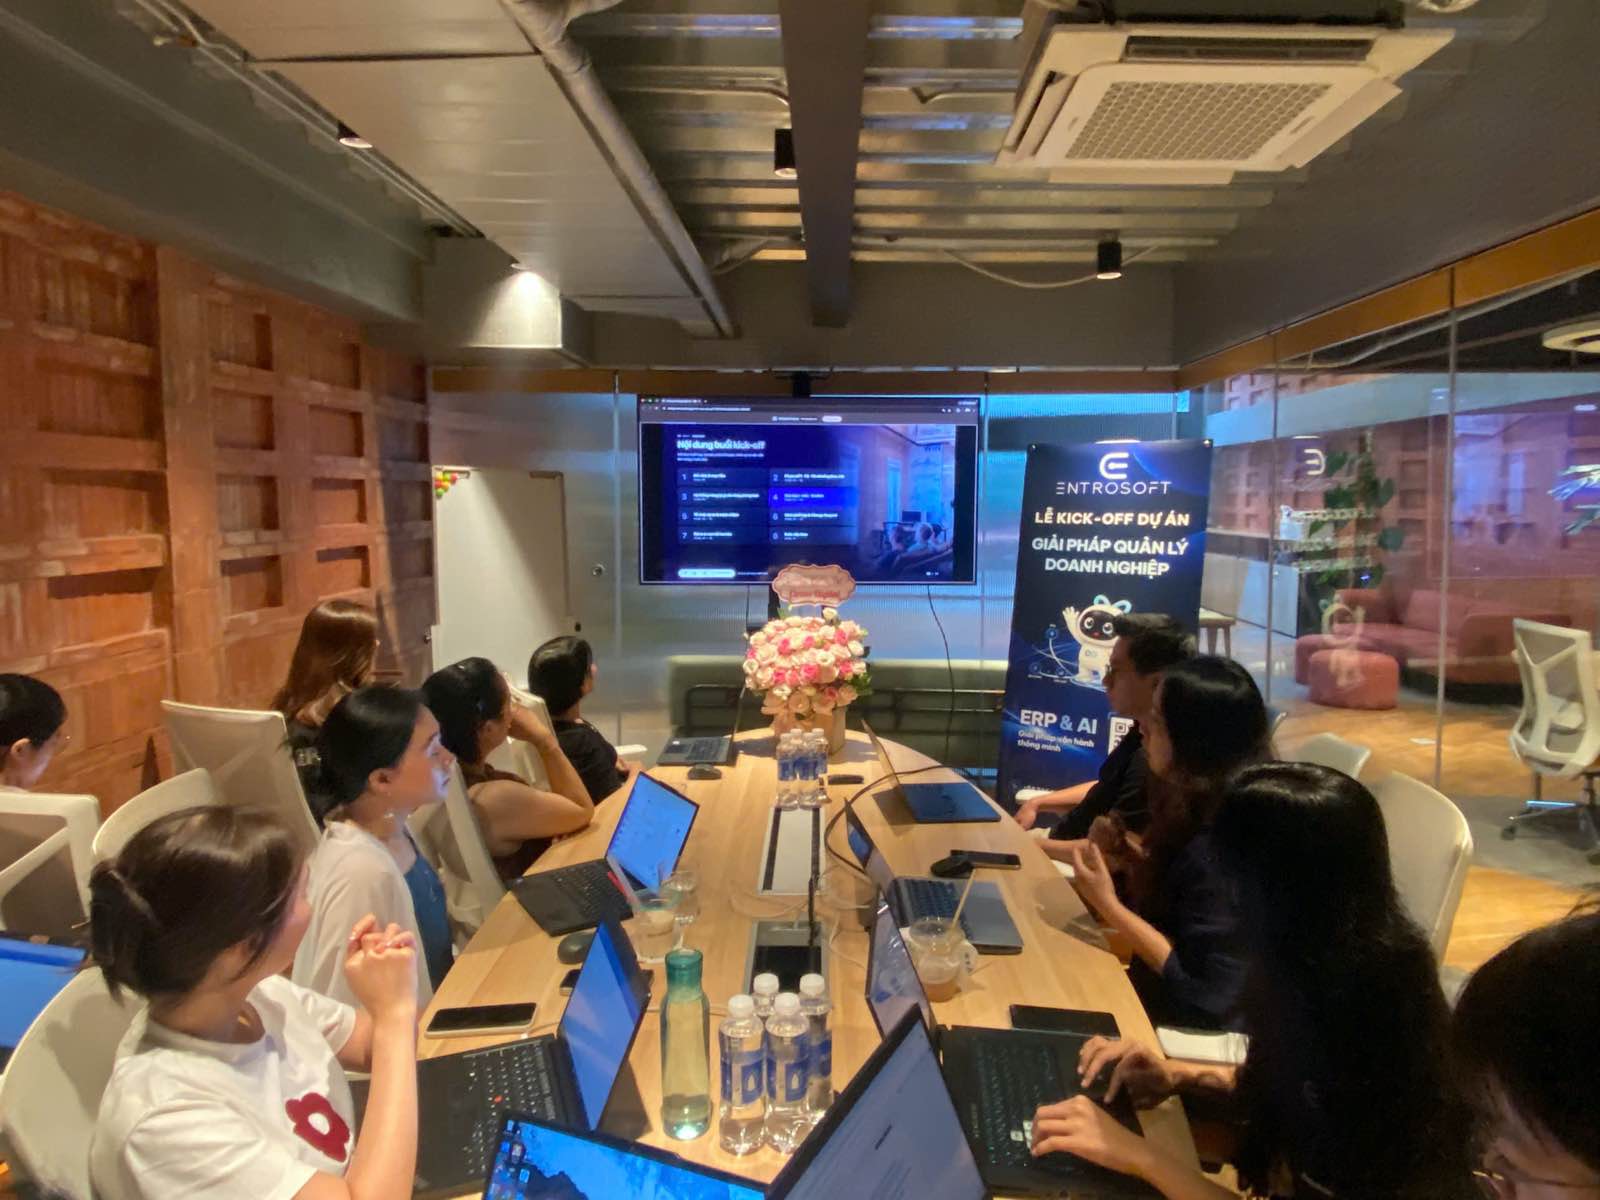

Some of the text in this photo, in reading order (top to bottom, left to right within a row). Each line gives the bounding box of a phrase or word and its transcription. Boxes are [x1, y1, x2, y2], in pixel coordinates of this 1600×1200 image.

[1056, 481, 1172, 495] ENTROSOFT
[1034, 506, 1190, 529] LỄ KICK-OFF DỰ ÁN
[1031, 534, 1189, 556] GIẢI PHÁP QUẢN LÝ
[1045, 558, 1170, 579] DOANH NGHIỆP
[1020, 709, 1098, 734] ERP & AI
[1041, 743, 1061, 752] minh
